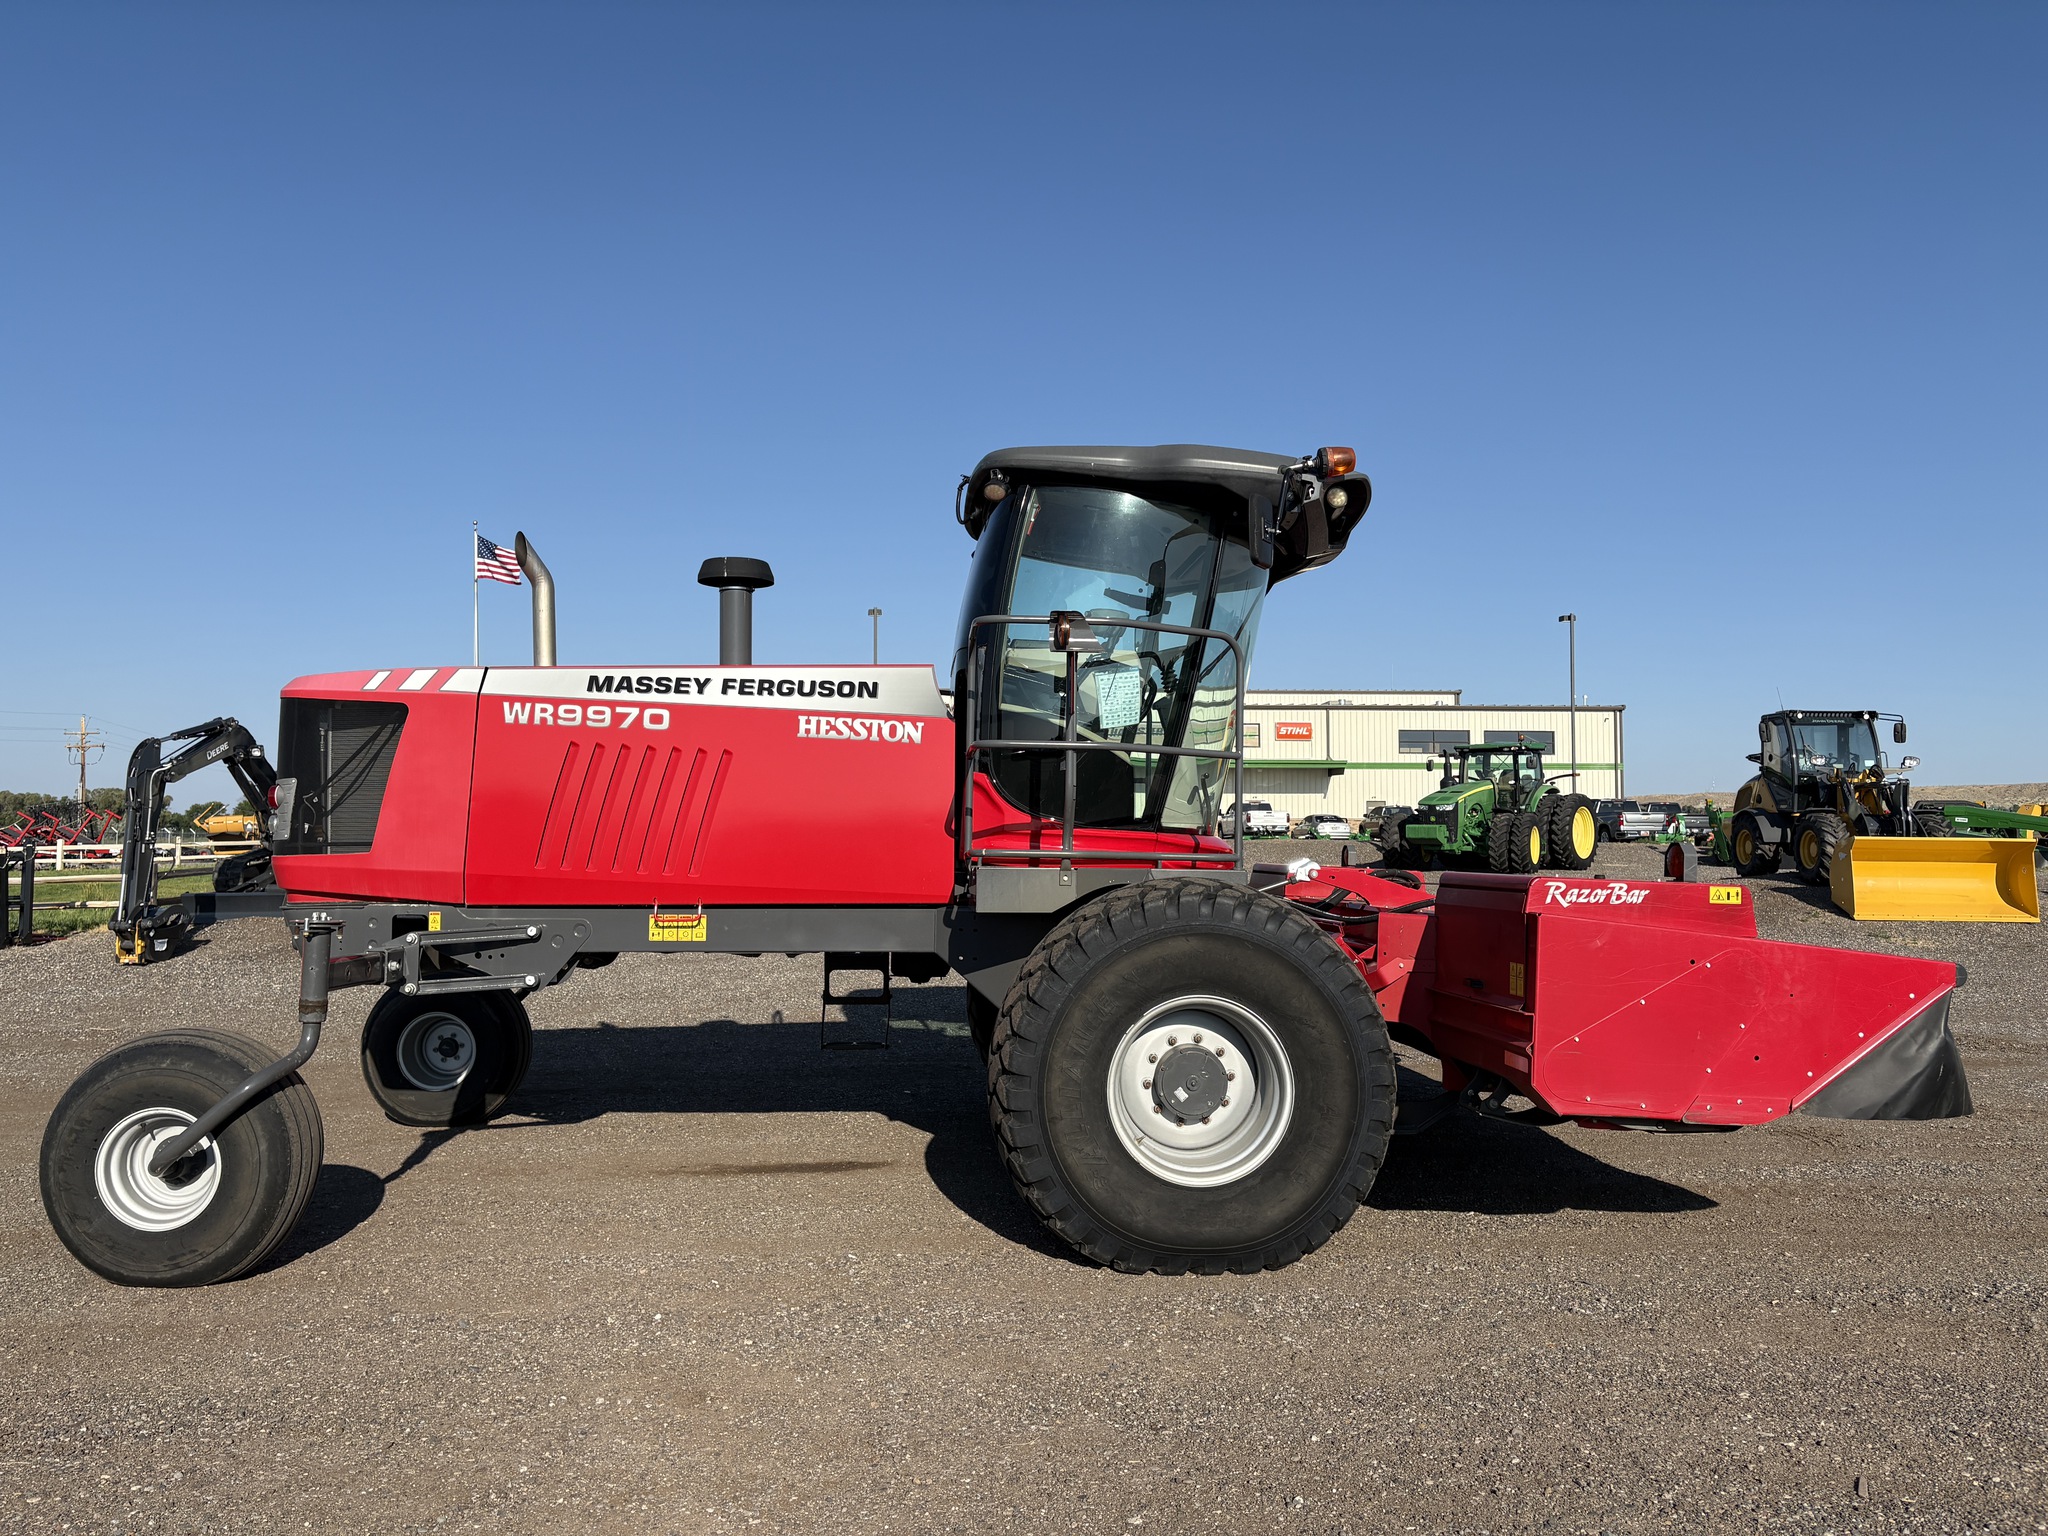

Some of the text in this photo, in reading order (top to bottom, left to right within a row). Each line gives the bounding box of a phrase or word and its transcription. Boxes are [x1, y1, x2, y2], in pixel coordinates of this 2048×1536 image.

[586, 675, 879, 698] MASSEY FERGUSON
[502, 701, 670, 730] WR9970
[796, 715, 925, 744] HESSTON
[1279, 726, 1310, 735] STIHL
[206, 741, 230, 760] DEERE
[1544, 882, 1650, 908] RazorBar
